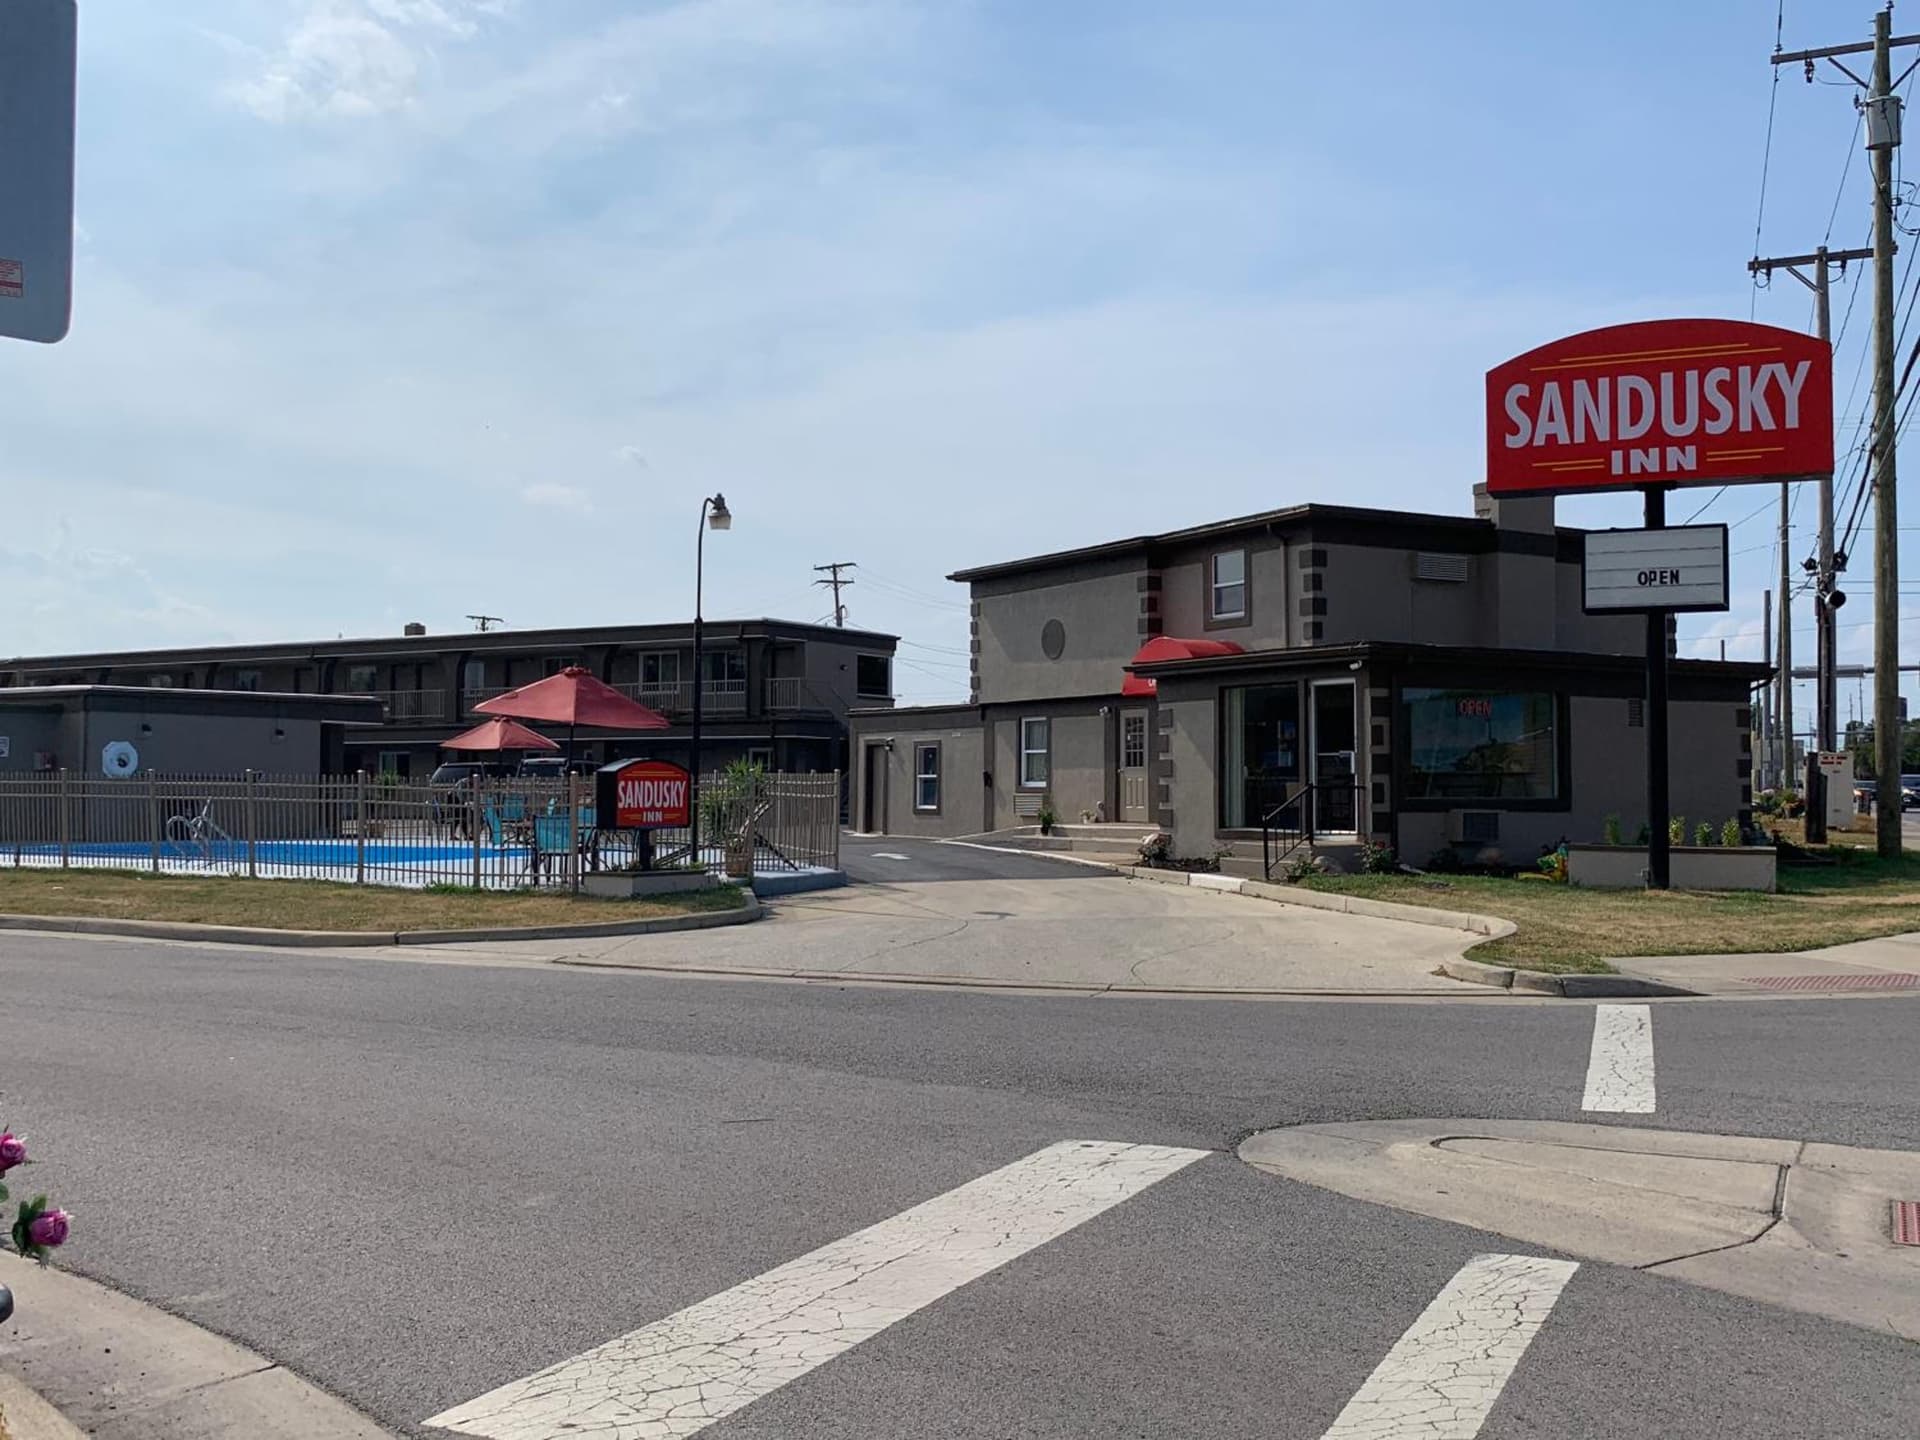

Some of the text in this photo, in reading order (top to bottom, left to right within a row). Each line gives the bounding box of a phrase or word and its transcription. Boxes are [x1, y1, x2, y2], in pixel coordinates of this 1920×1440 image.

[1504, 360, 1812, 448] SANDUSKY
[1611, 445, 1697, 475] INN
[1637, 569, 1680, 587] OPEN
[617, 780, 687, 809] SANDUSKY
[642, 811, 663, 823] INN
